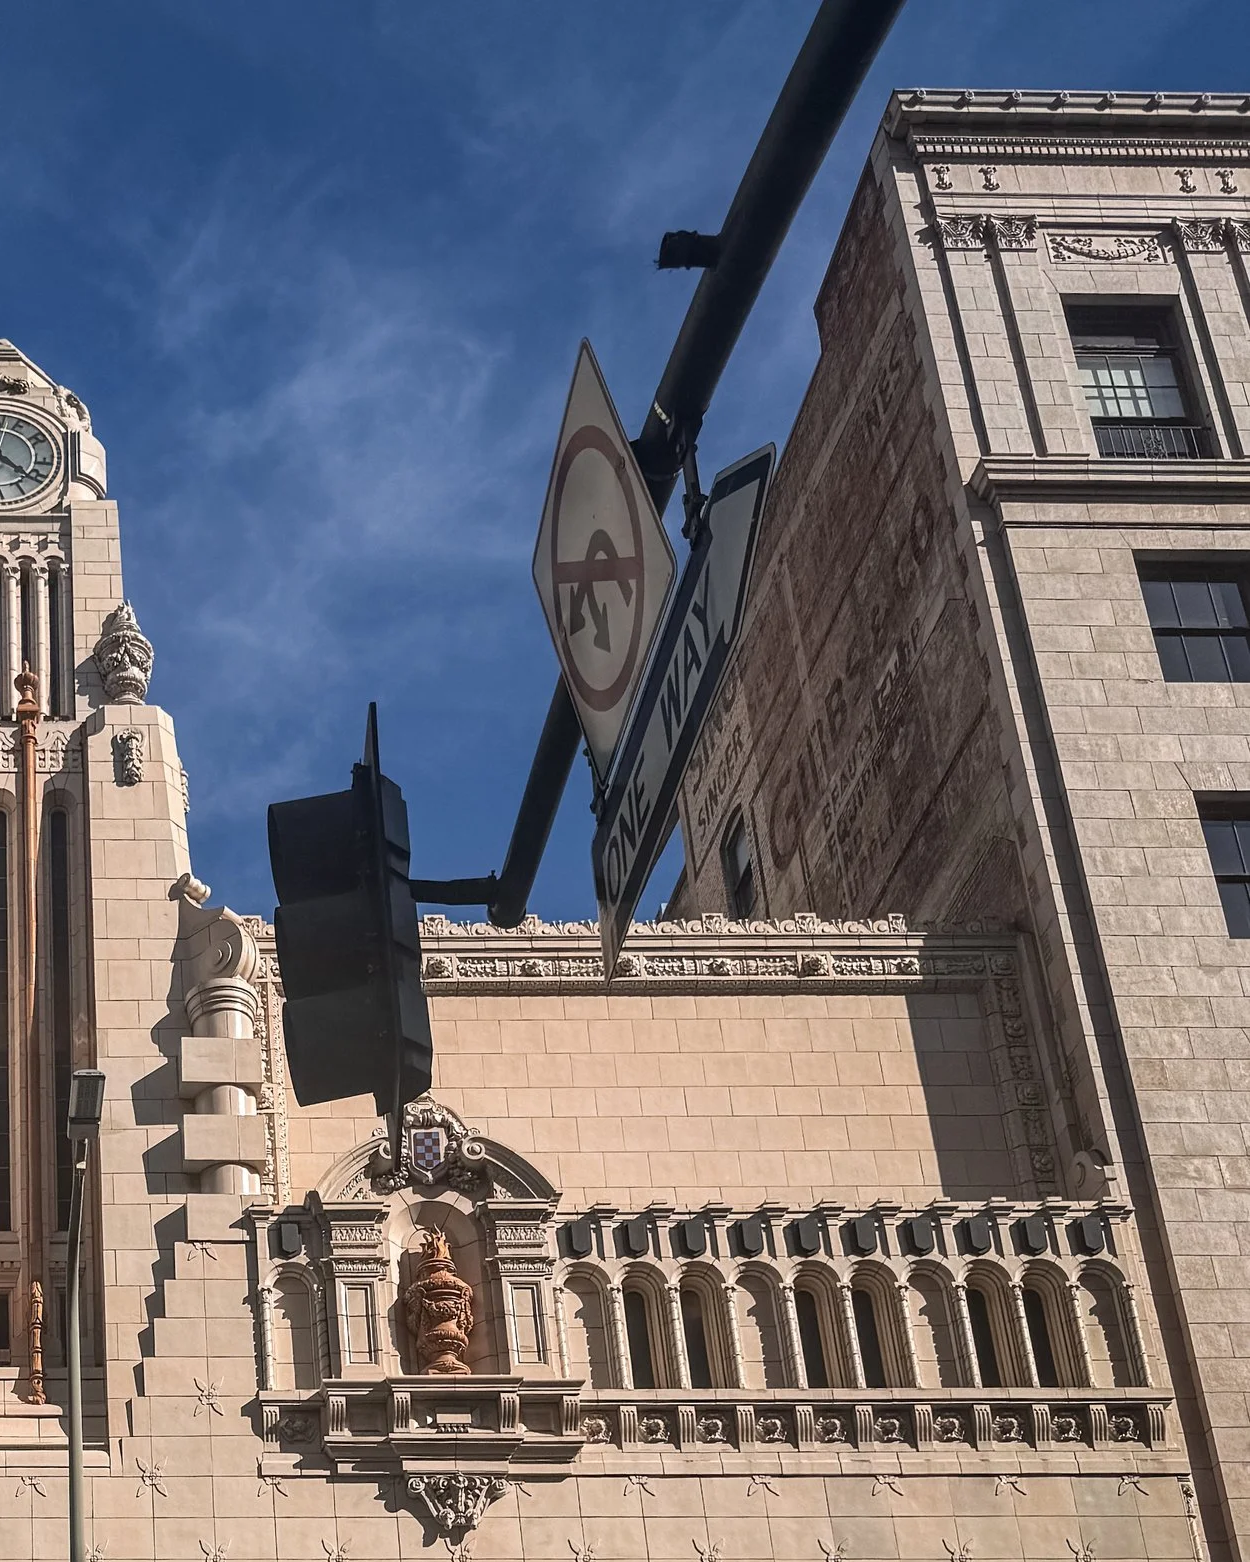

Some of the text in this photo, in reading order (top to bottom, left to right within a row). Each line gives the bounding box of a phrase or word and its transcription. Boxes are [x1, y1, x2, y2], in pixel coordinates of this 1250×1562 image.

[606, 563, 713, 908] ONE WAY
[698, 726, 744, 834] SINGER
